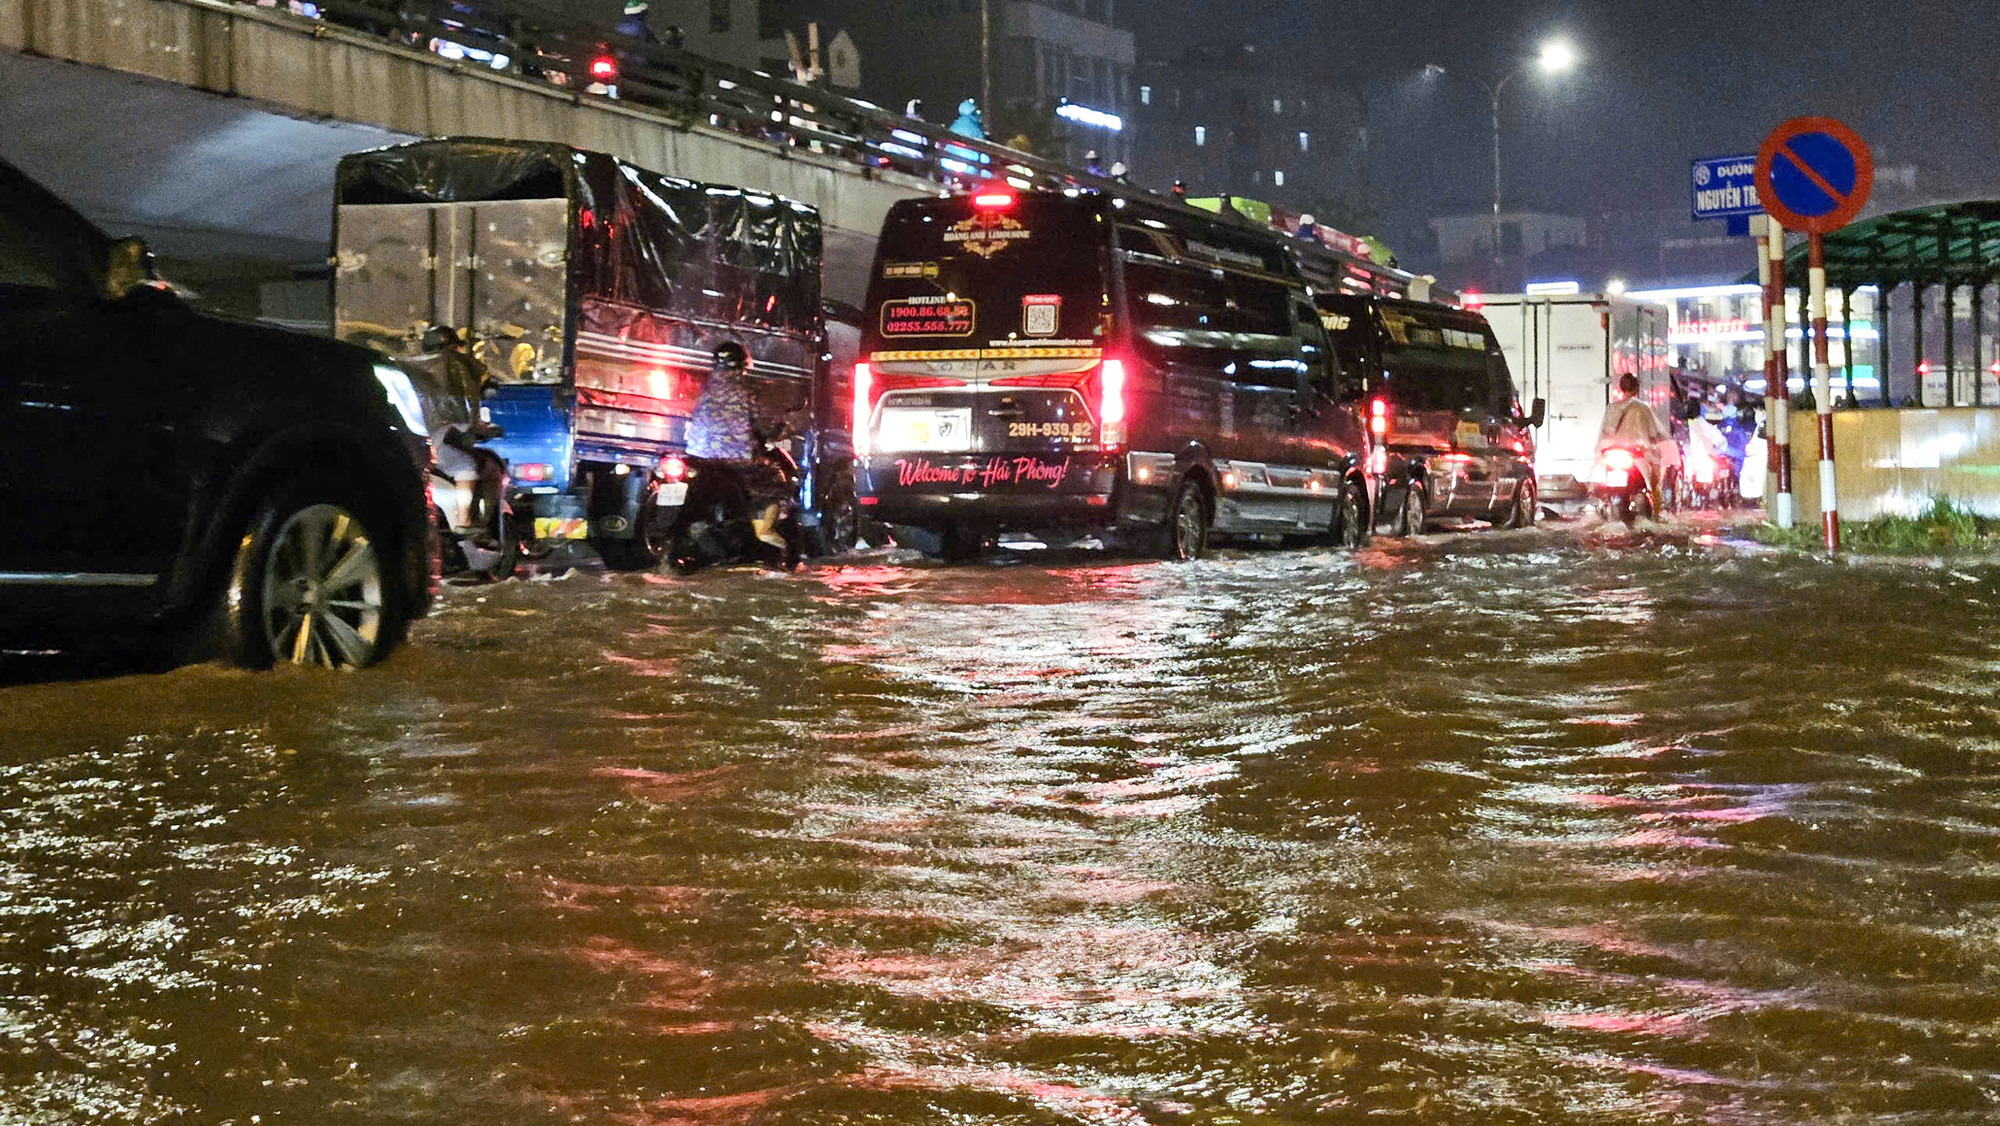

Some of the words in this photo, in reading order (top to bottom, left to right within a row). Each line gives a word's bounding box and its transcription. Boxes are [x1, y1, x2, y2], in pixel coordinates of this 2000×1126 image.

[1717, 160, 1755, 178] ĐƯỜN
[1697, 180, 1741, 211] NGUYỄN
[1743, 185, 1760, 206] TR
[988, 230, 1030, 239] LIMOUSINE
[908, 296, 946, 304] HOTLINE
[1700, 319, 1748, 334] COFFEE
[895, 458, 960, 486] Welcome
[962, 461, 977, 485] to
[1013, 456, 1070, 488] Phòng!
